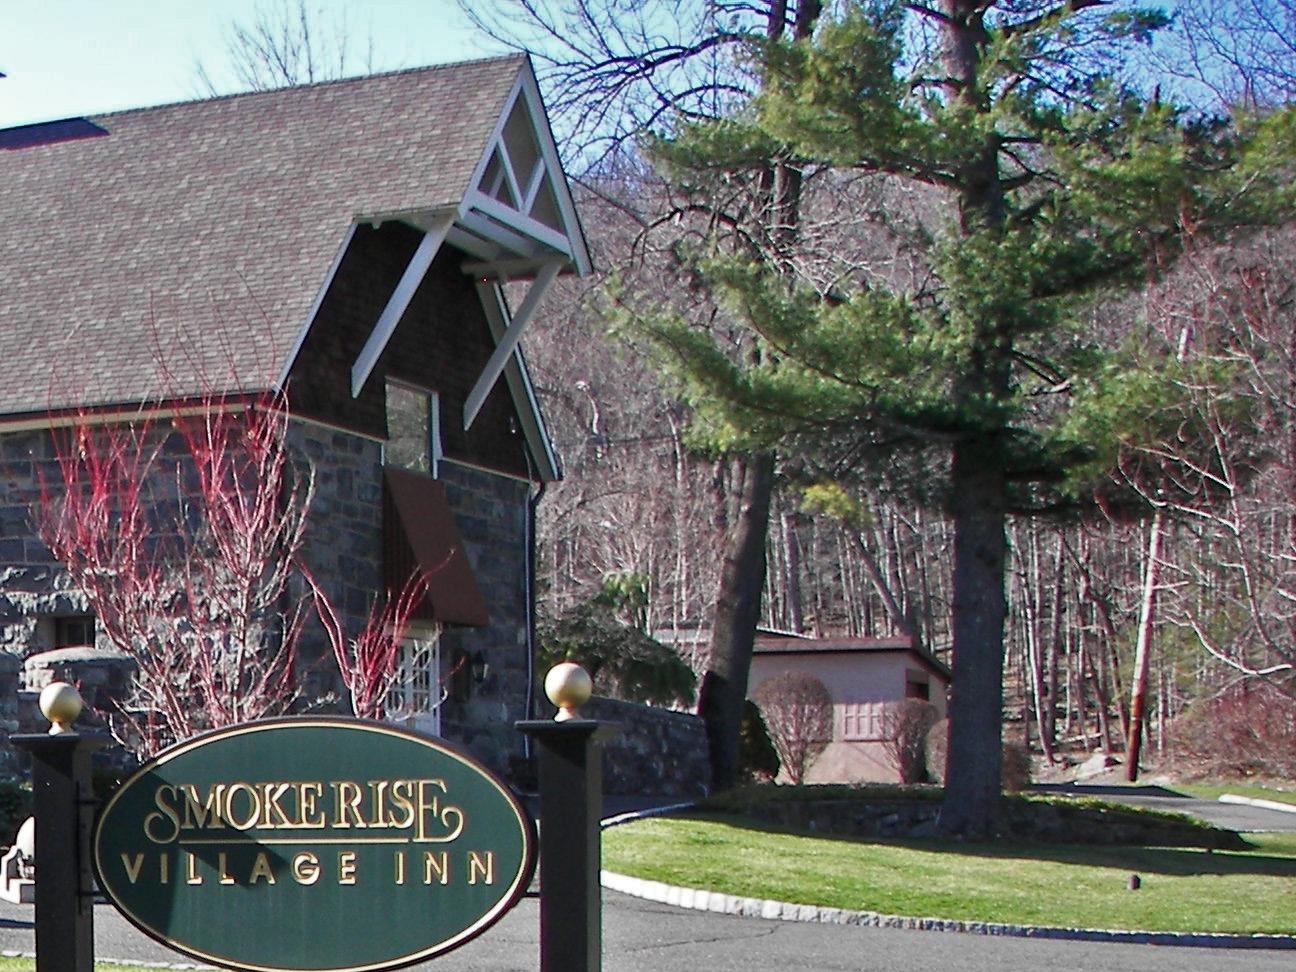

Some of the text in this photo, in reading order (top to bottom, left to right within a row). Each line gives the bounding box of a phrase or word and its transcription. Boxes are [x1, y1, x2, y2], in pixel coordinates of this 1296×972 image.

[144, 778, 464, 844] SMOKE RISE
[120, 850, 493, 886] VILLAGE INN
